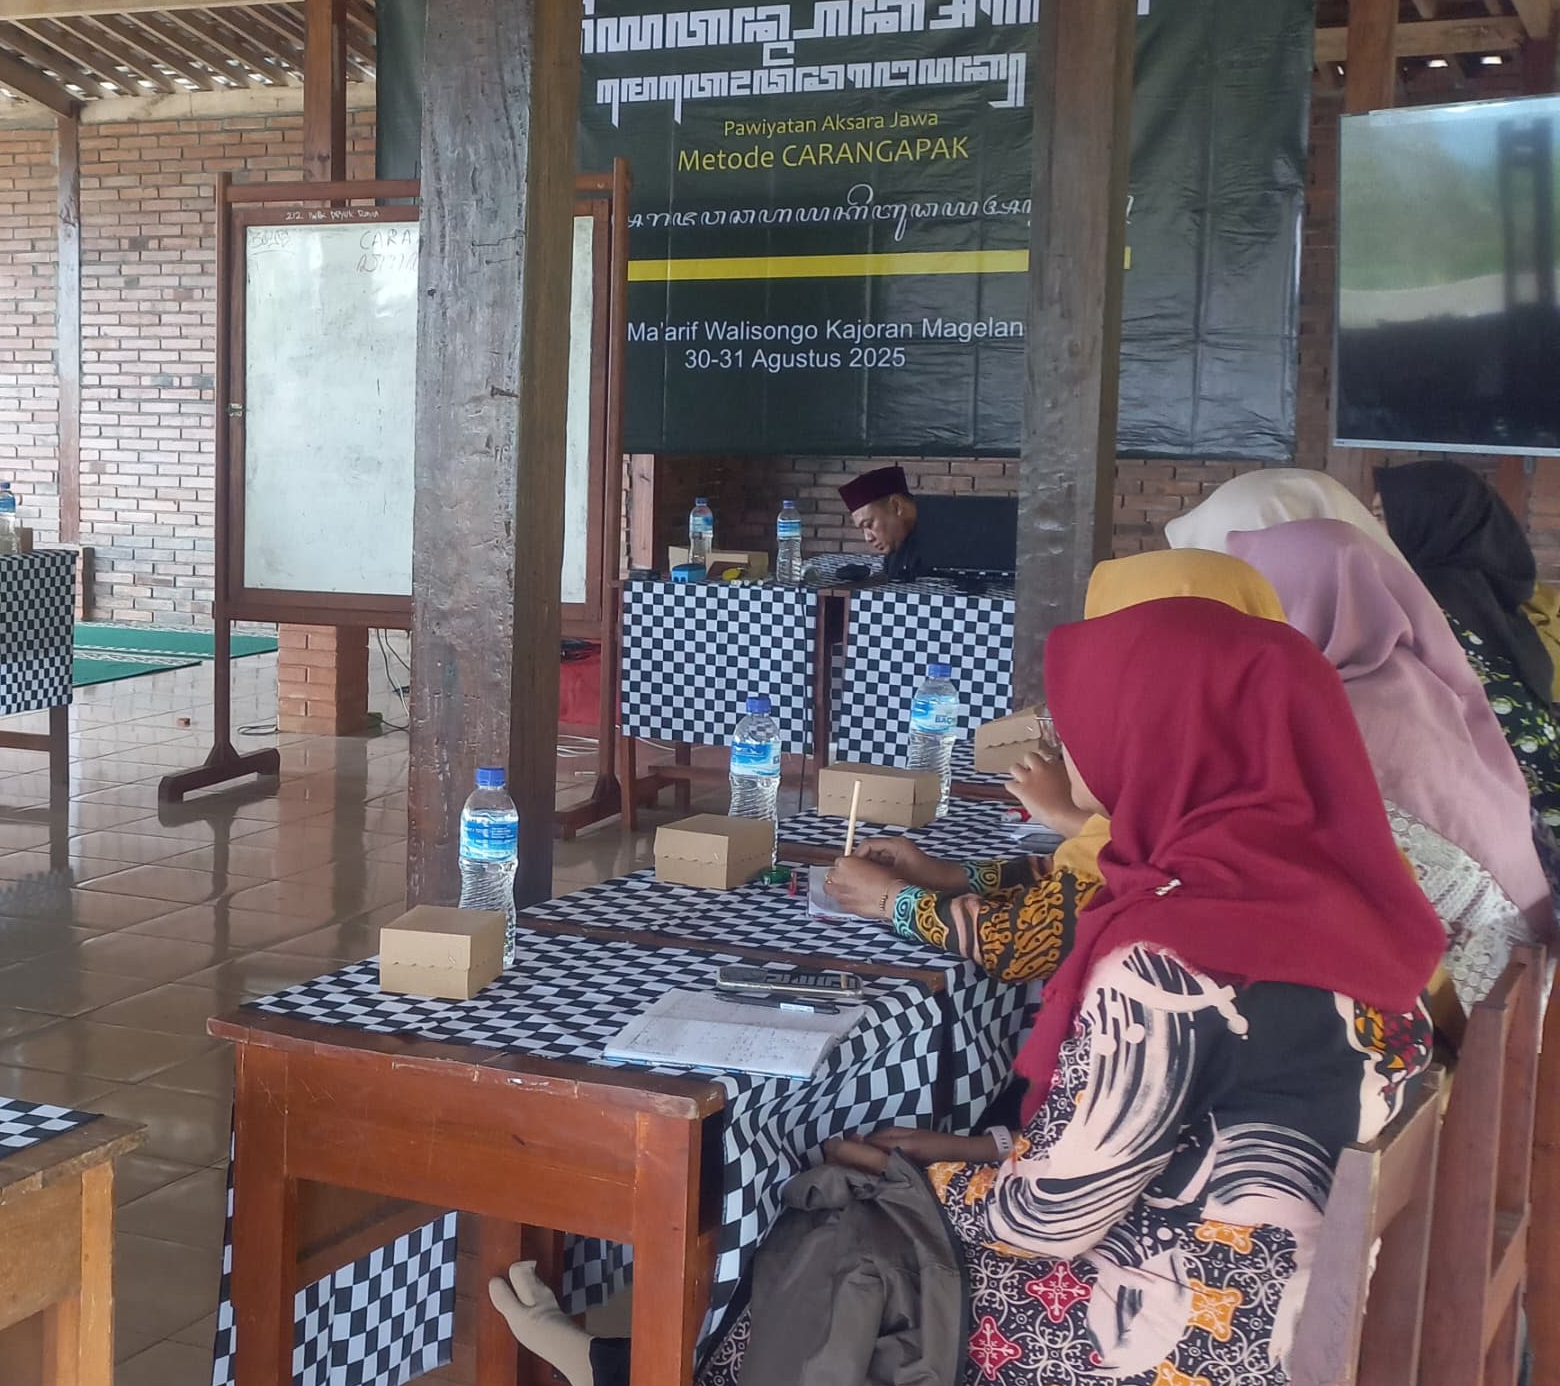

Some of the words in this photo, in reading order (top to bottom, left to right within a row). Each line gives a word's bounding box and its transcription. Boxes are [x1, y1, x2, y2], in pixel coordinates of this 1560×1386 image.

[724, 117, 816, 139] Pawiyatan
[821, 113, 885, 132] Aksara
[889, 111, 939, 129] Jawa
[677, 145, 775, 172] Metode
[781, 135, 970, 167] CARANGAPAK
[359, 228, 413, 250] CARA
[627, 321, 699, 342] Ma'arif
[704, 319, 818, 346] Walisongo
[826, 318, 913, 344] Kajoran
[921, 316, 1024, 343] Magelan
[684, 348, 744, 370] 30-31
[751, 348, 842, 373] Agustus
[848, 346, 906, 368] 2025
